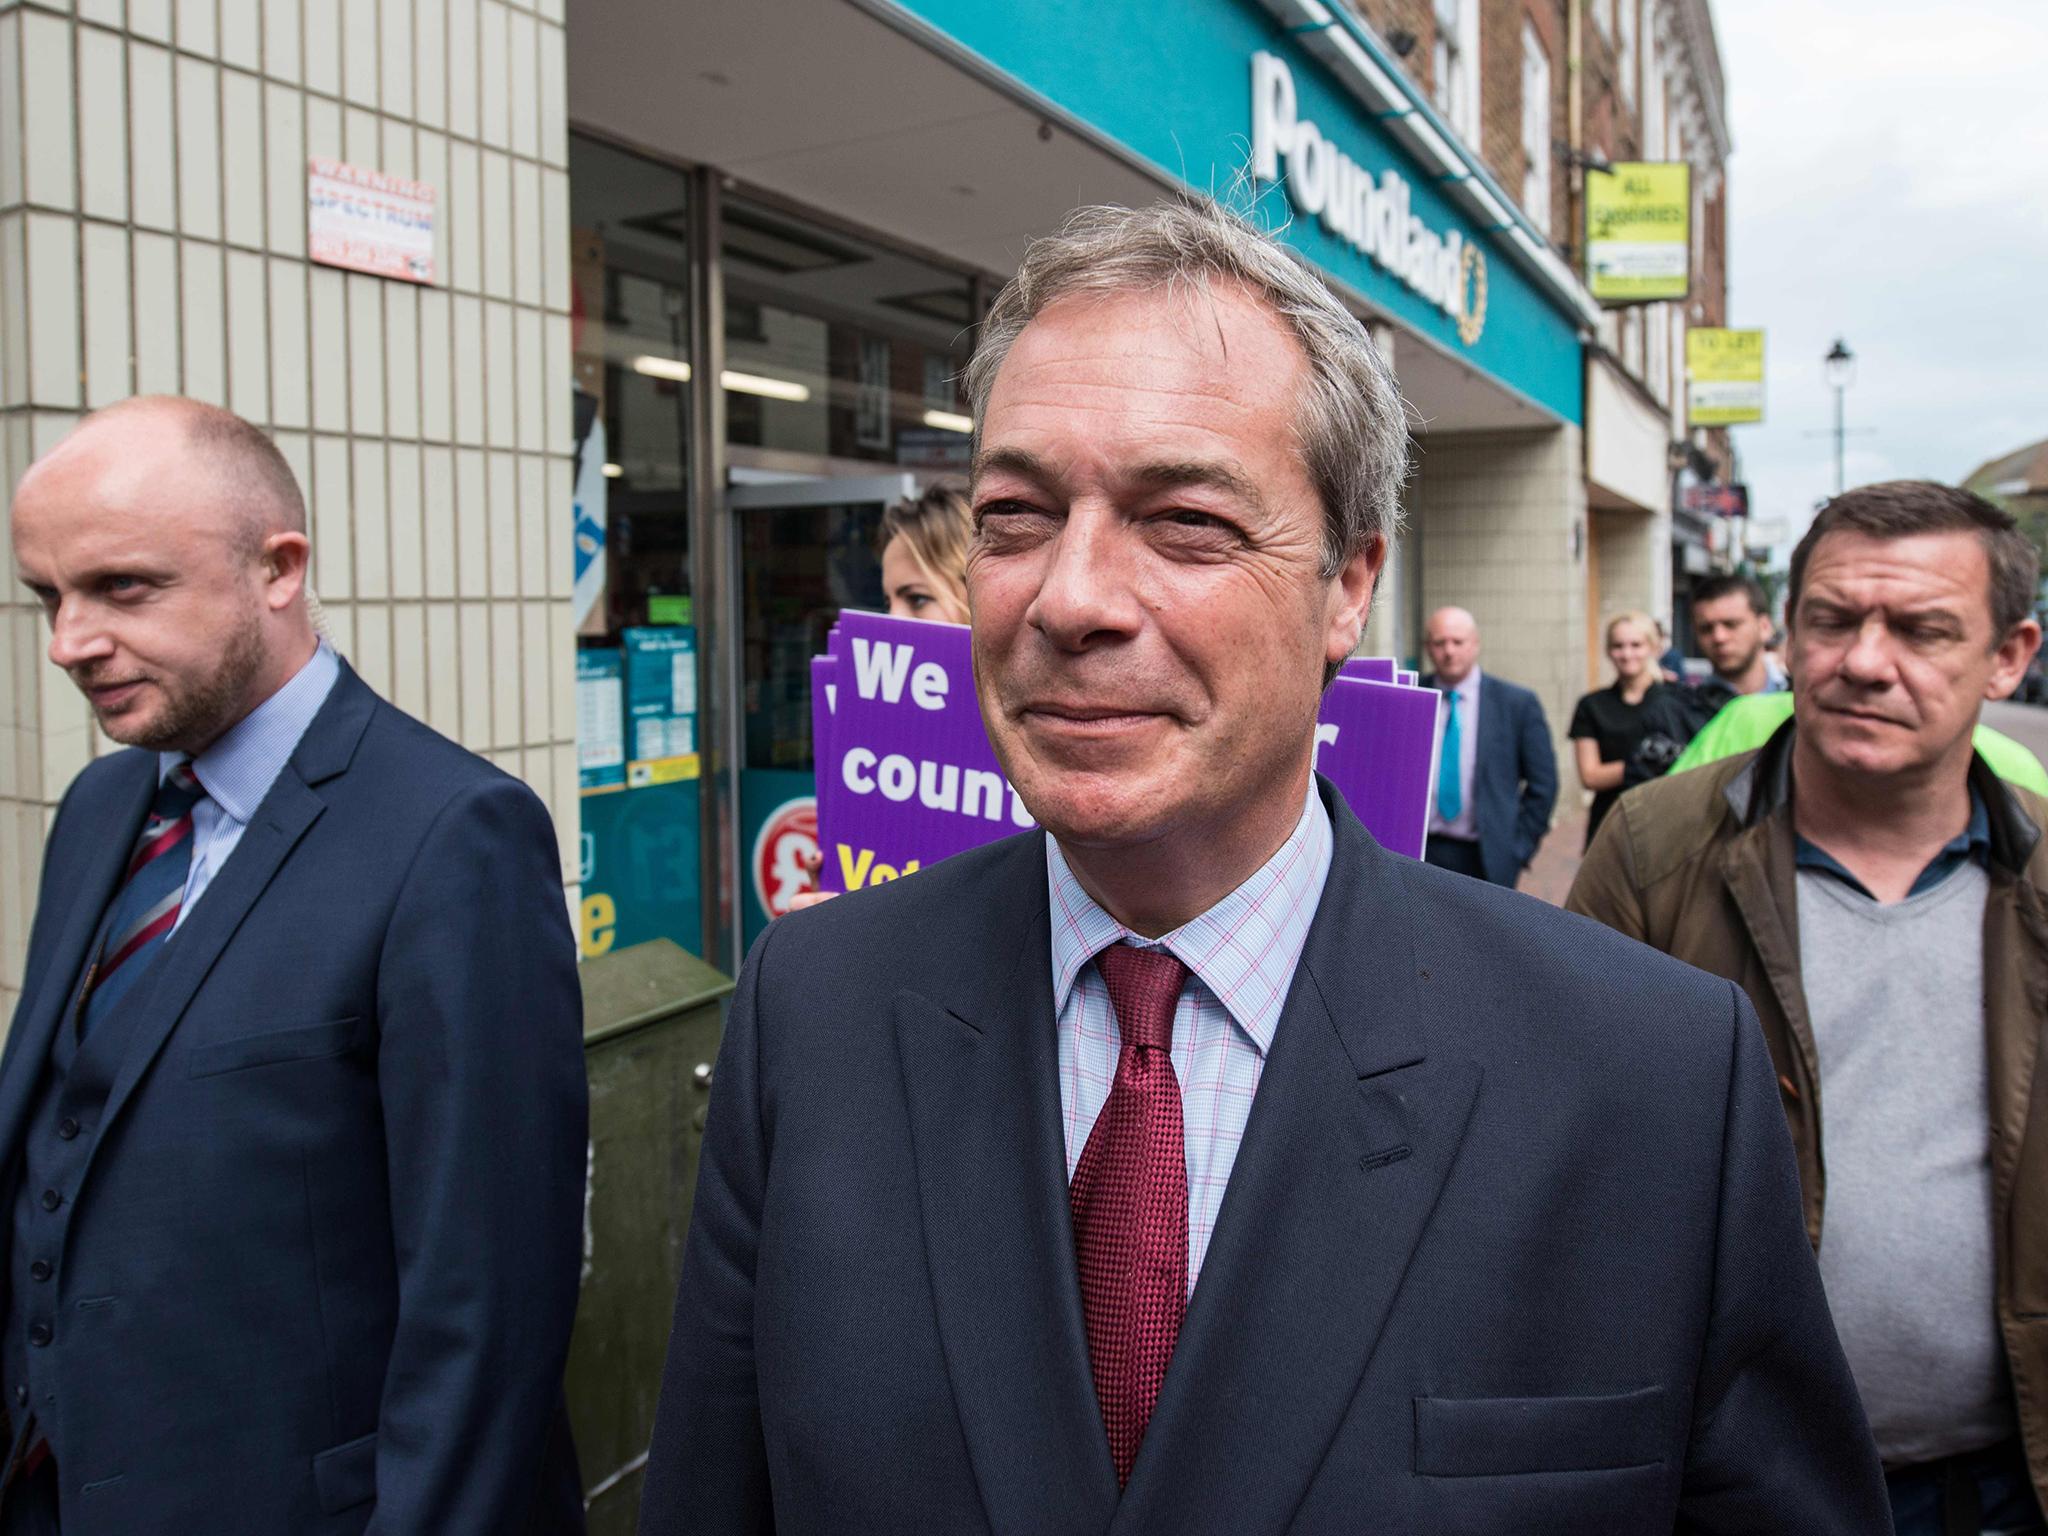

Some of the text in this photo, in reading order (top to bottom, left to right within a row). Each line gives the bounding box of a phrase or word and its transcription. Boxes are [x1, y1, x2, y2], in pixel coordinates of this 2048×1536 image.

[311, 187, 431, 230] SPECTRUM
[1253, 50, 1462, 316] Poundland
[1624, 178, 1651, 195] ALL
[851, 637, 949, 711] We
